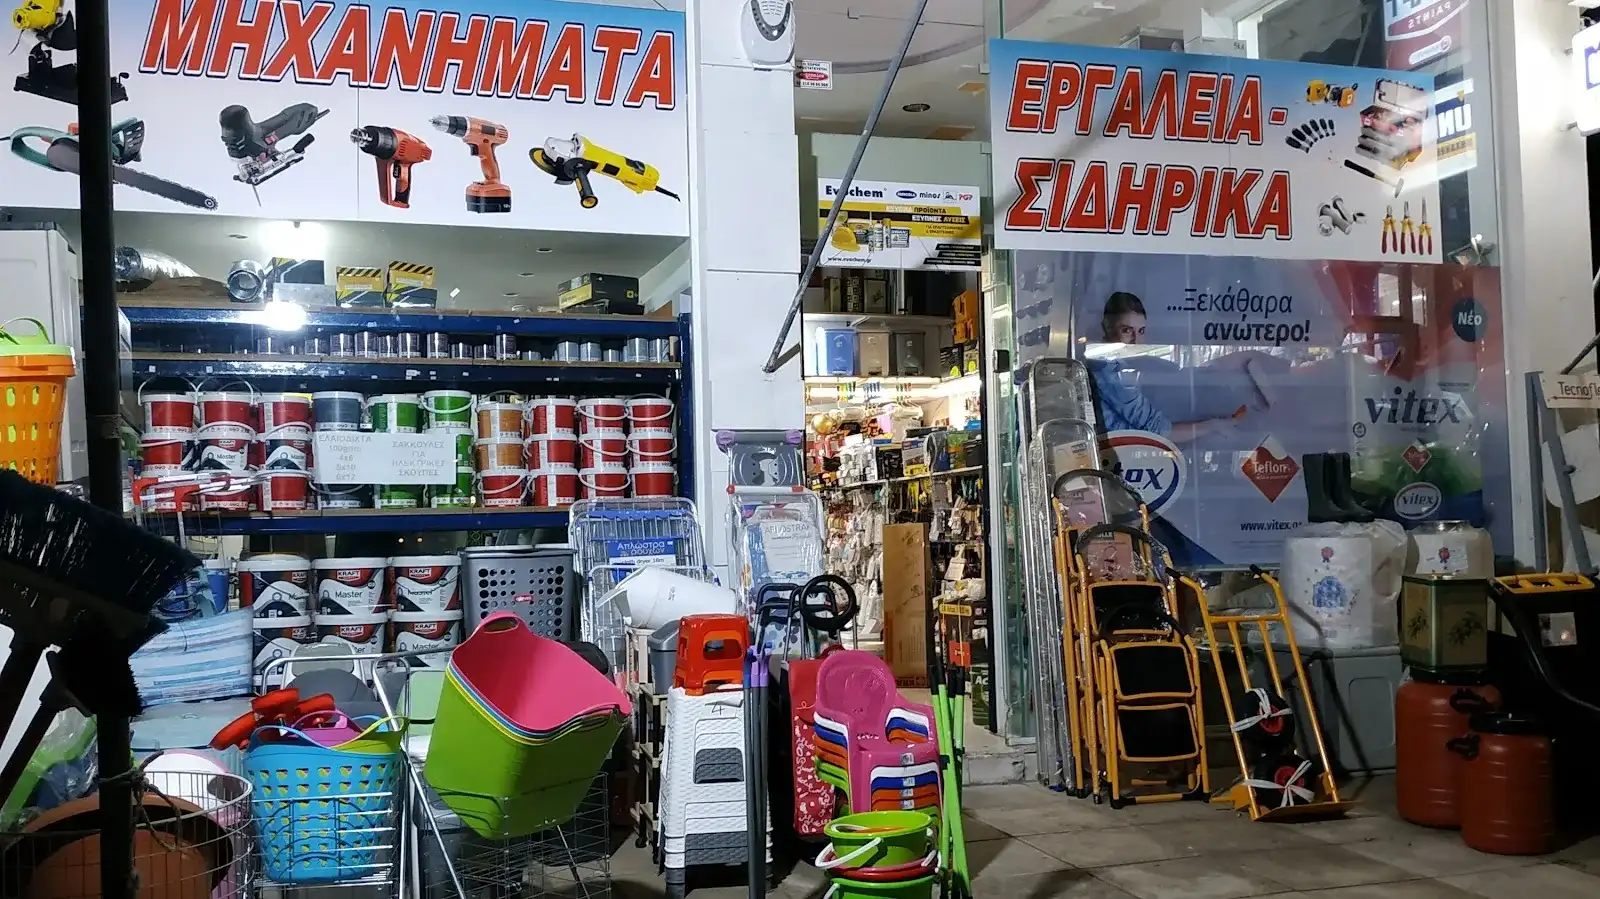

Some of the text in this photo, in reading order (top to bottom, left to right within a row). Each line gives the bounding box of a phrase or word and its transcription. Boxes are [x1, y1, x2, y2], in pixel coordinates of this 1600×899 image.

[139, 0, 676, 109] ΜΗΧΑΝΗΜΑΤΑ
[1004, 157, 1293, 240] ΣΙΔΗΡΙΚΑ
[1457, 309, 1483, 326] Νέο
[1204, 314, 1311, 346] ανώτερο!
[1364, 386, 1460, 424] vitex
[392, 441, 444, 449] ΣΑΚΚΟΥΛΕΣ
[1402, 492, 1434, 505] vitex
[617, 540, 665, 551] Απλώστρα
[335, 590, 363, 599] Master
[412, 643, 438, 651] Master
